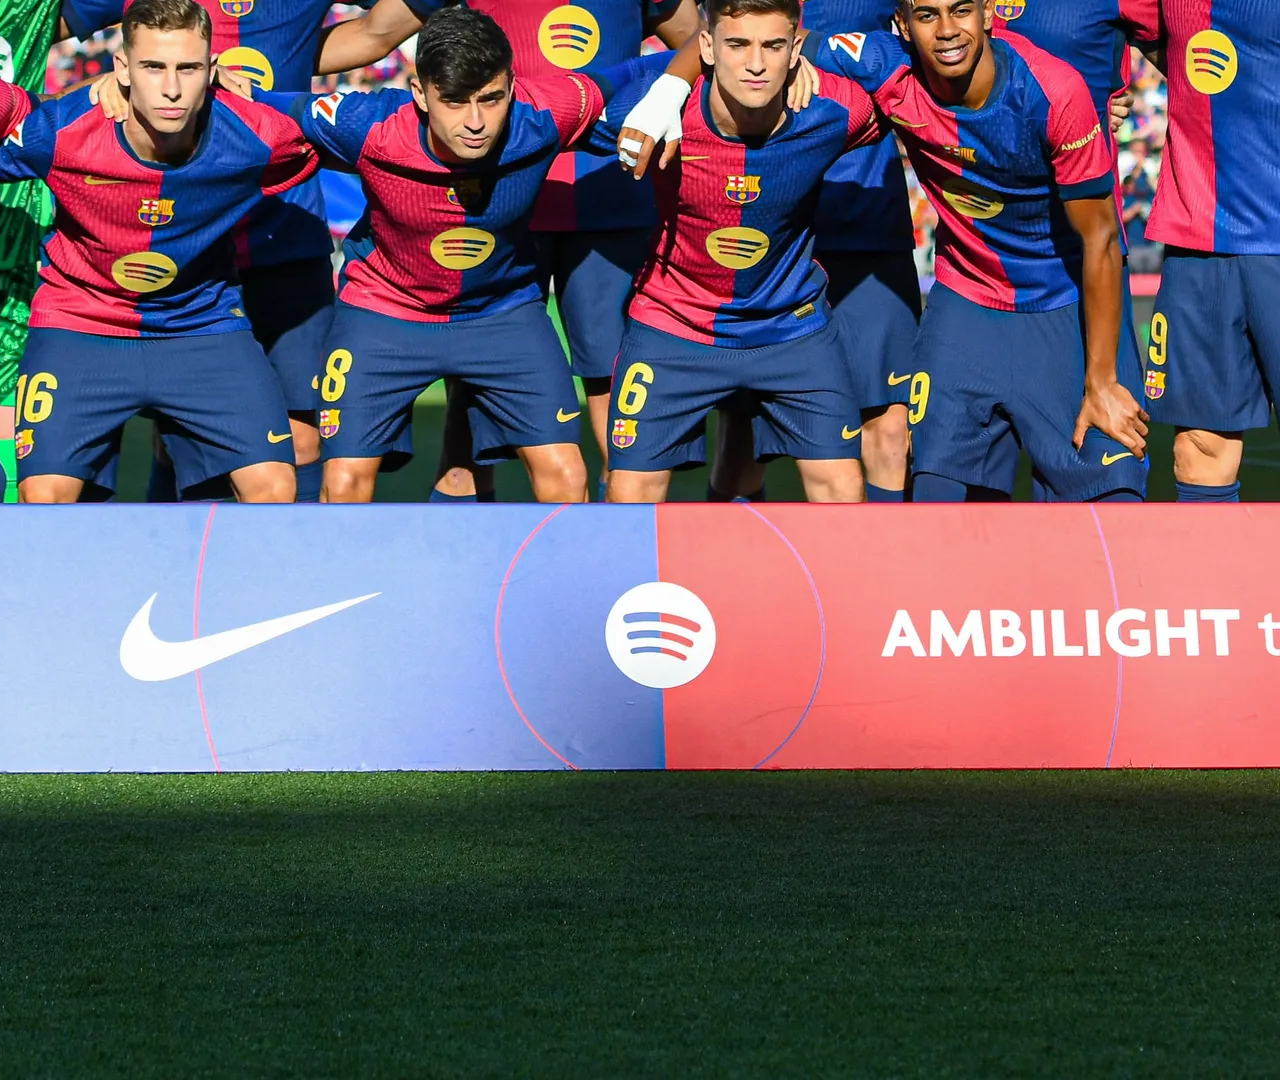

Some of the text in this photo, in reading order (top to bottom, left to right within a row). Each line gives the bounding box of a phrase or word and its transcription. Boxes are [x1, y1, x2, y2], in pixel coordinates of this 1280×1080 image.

[1149, 312, 1168, 365] 9
[15, 372, 58, 427] 16
[320, 349, 353, 402] 8
[617, 362, 654, 415] 6
[908, 371, 931, 425] 9
[881, 608, 1240, 657] AMBILIGHT
